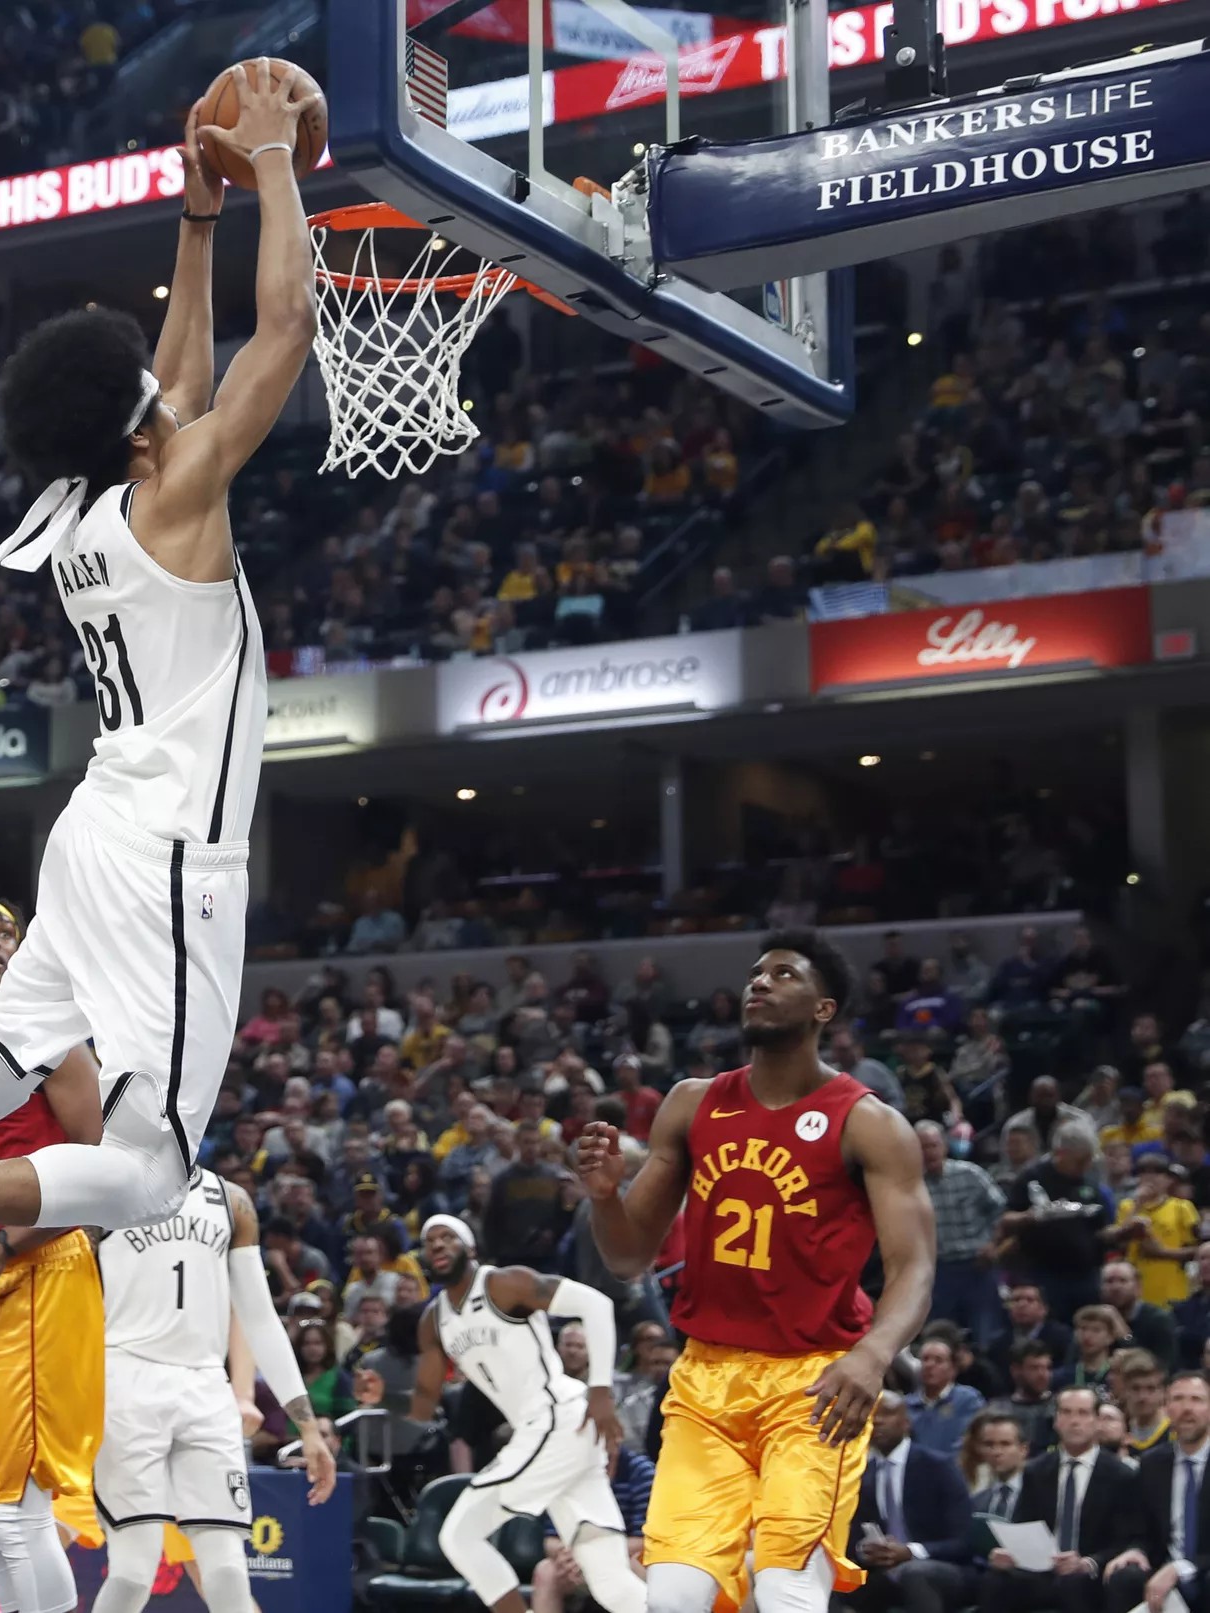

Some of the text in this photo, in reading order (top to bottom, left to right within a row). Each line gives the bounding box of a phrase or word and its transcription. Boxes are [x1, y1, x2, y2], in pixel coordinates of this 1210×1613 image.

[67, 147, 185, 214] BUD'S
[816, 130, 1155, 211] FIELDHOUSE
[917, 609, 1037, 668] Lilly
[81, 613, 144, 731] 31
[540, 655, 701, 698] ambrose
[692, 1137, 818, 1217] HICKORY
[124, 1215, 230, 1258] BROOKLYN
[714, 1198, 774, 1271] 21
[172, 1260, 184, 1310] 1
[247, 1554, 293, 1570] ndiana
